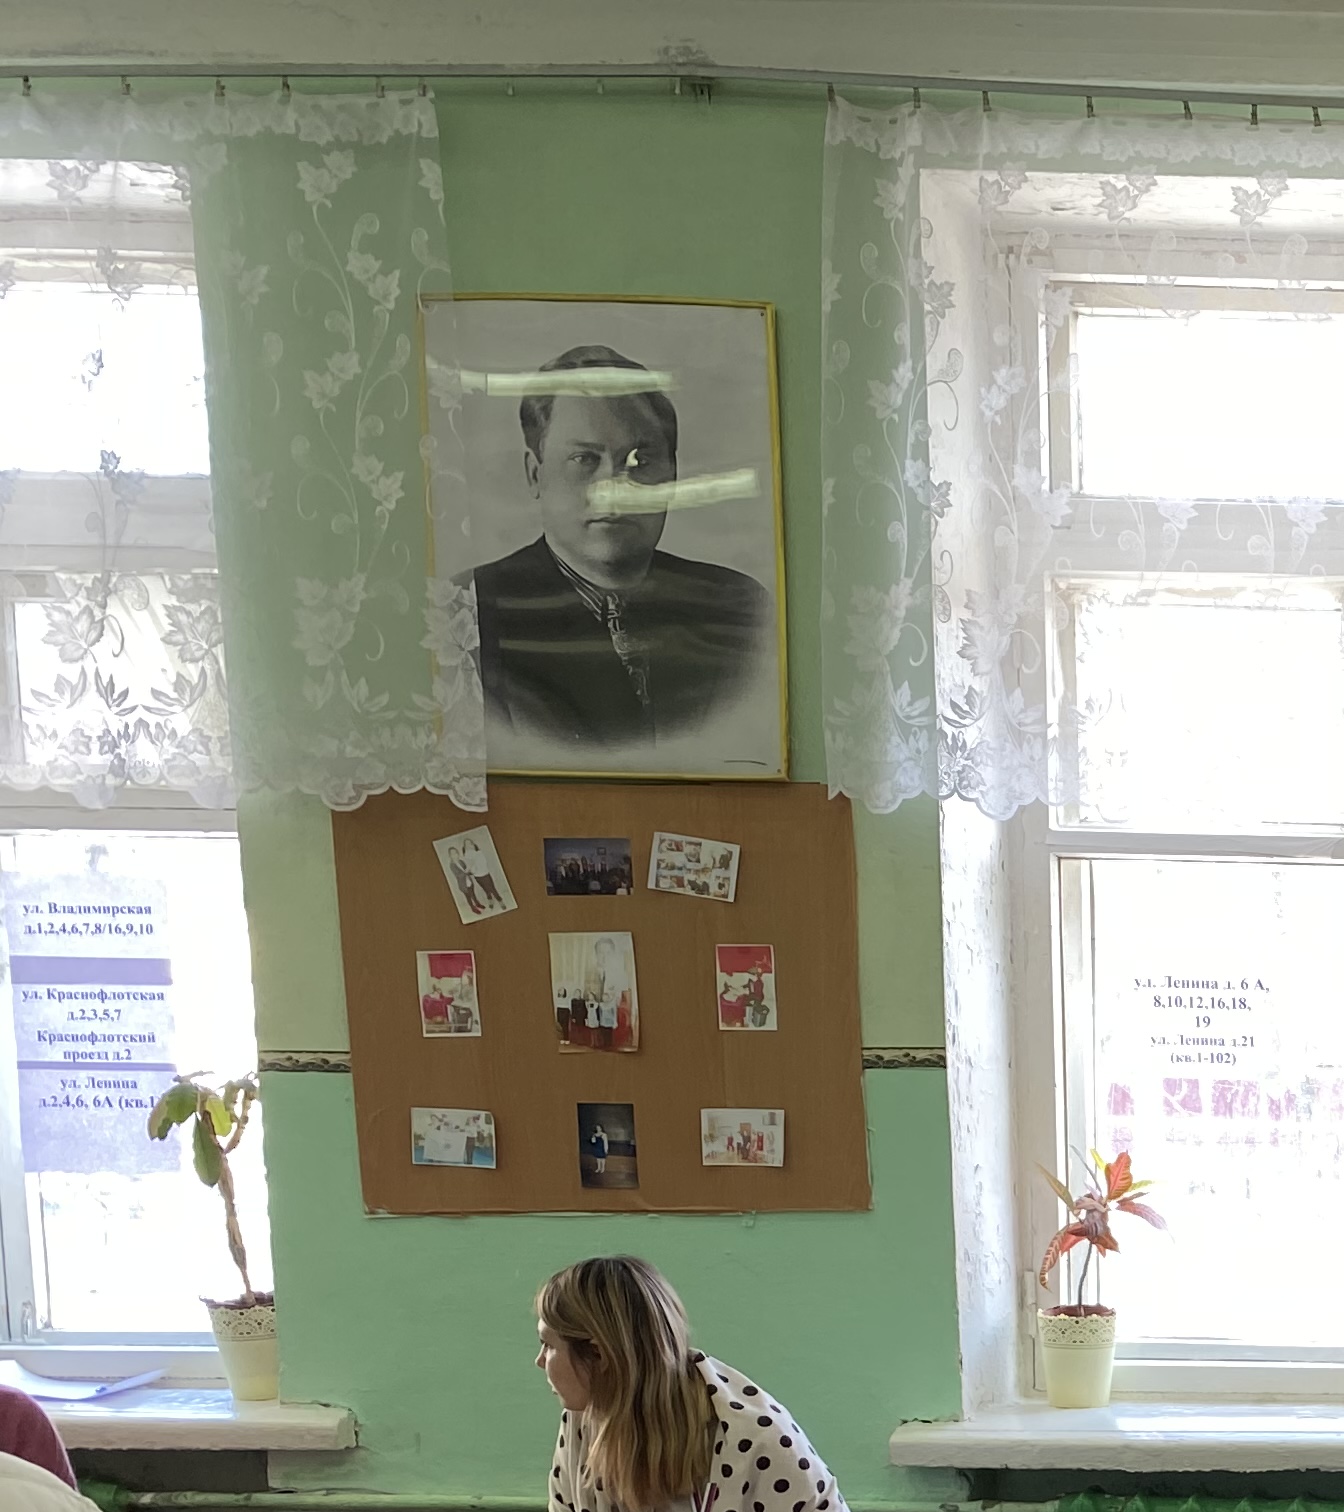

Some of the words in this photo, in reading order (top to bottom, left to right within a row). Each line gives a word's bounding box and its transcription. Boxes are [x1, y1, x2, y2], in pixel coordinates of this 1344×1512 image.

[23, 904, 43, 917] ул.
[48, 901, 152, 917] Владимирская
[1134, 978, 1156, 991] ул.
[1160, 976, 1218, 989] Ленина
[1240, 978, 1249, 990] 6
[21, 990, 43, 1002] ул.
[46, 988, 165, 1003] Краснофлотская
[1153, 995, 1251, 1011] 8,10,12,16,18,
[66, 1009, 122, 1022] д.2,3,5,7
[1195, 1016, 1211, 1028] 19
[37, 1030, 156, 1045] Краснофлотский
[1150, 1036, 1171, 1047] ул.
[1173, 1034, 1225, 1046] Ленина
[1231, 1036, 1254, 1047] д.21
[63, 1050, 109, 1062] проезд
[112, 1049, 132, 1061] д.2
[1170, 1052, 1237, 1066] (кв.1-102)
[60, 1078, 81, 1091] ул.
[85, 1077, 138, 1089] Ленина
[92, 1095, 113, 1108] 6А
